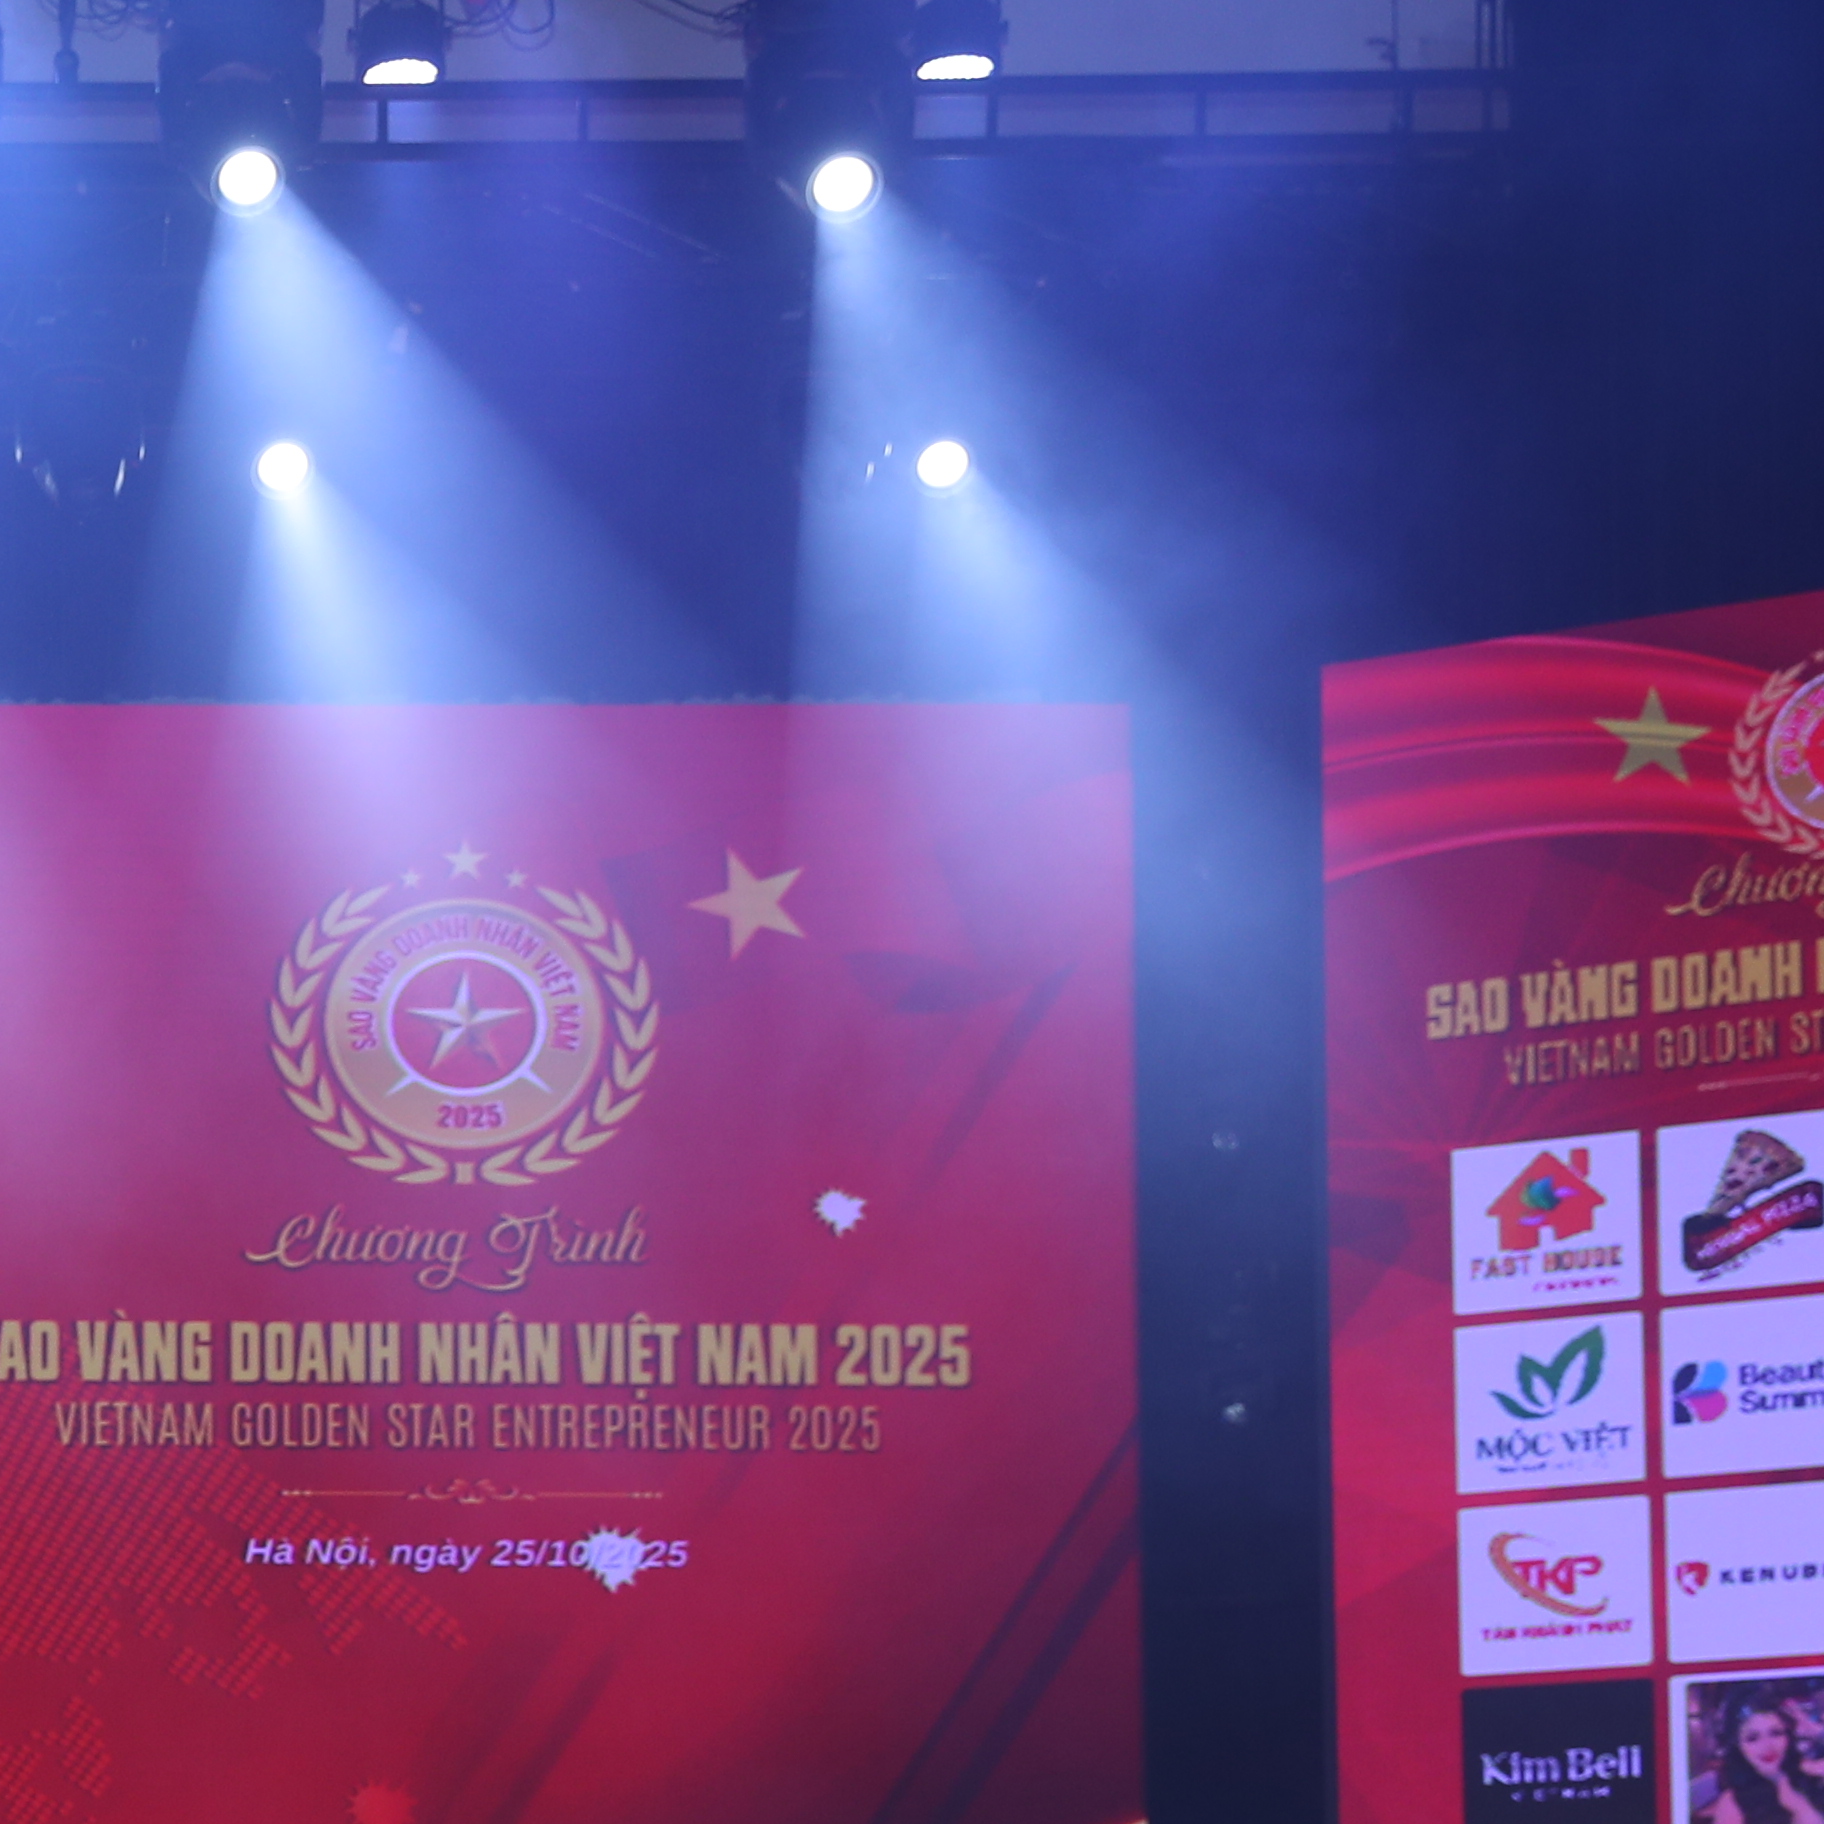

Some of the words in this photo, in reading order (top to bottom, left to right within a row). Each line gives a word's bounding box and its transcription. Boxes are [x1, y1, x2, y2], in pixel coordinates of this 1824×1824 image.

[1664, 851, 1824, 919] Chươn
[1426, 976, 1509, 1040] SAO
[1520, 957, 1638, 1030] VÀNG
[1651, 939, 1802, 1013] DOANH
[1505, 1030, 1640, 1086] VIETNAM
[1656, 1014, 1776, 1071] GOLDEN
[436, 1104, 503, 1128] 2025
[245, 1204, 468, 1290] Chương
[490, 1206, 650, 1291] Trình
[1470, 1255, 1532, 1280] FAST
[75, 1309, 213, 1384] VÀNG
[231, 1320, 402, 1385] DOANH
[420, 1311, 560, 1386] NHÂN
[577, 1311, 679, 1400] VIỆT
[699, 1323, 818, 1387] NAM
[836, 1323, 972, 1387] 2025
[54, 1399, 214, 1448] VIETNAM
[231, 1401, 370, 1449] GOLDEN
[387, 1401, 476, 1450] STAR
[493, 1402, 771, 1453] ENTREPRENEUR
[789, 1404, 881, 1453] 2025
[245, 1537, 298, 1566] Hà
[306, 1536, 377, 1571] Nội,
[390, 1543, 481, 1573] ngày
[1720, 1561, 1824, 1586] KENUB
[1565, 1744, 1642, 1782] Bell
